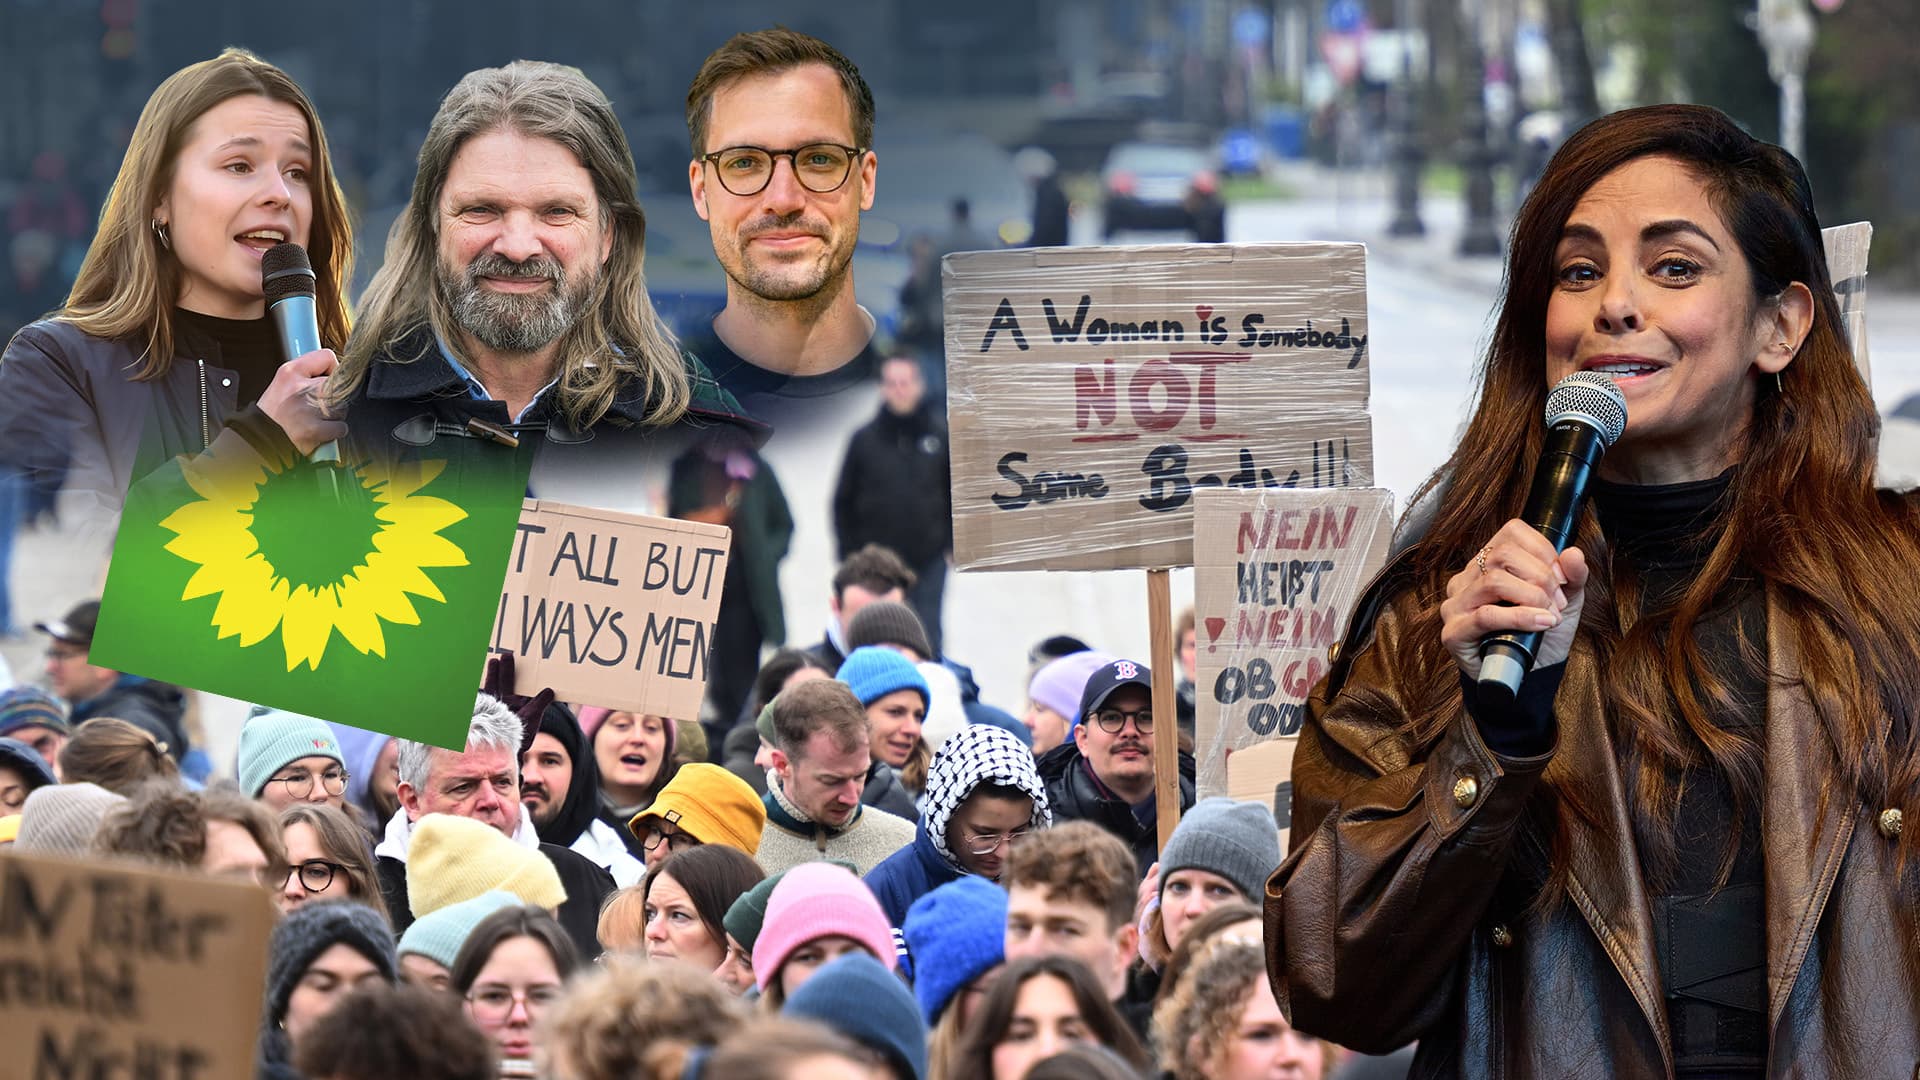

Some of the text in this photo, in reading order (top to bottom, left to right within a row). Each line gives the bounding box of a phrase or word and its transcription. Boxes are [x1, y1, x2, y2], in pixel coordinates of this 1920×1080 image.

[980, 295, 1367, 370] A Woman is Somebody
[1073, 352, 1252, 432] NOT
[991, 452, 1110, 511] Some
[1237, 506, 1358, 553] NEIN
[549, 531, 619, 586] ALL
[642, 542, 725, 600] BUT
[488, 592, 717, 682] LWAYS MEN
[1236, 609, 1336, 649] NEIN
[1114, 661, 1138, 680] B
[1214, 657, 1276, 704] OB
[1247, 703, 1306, 736] OD
